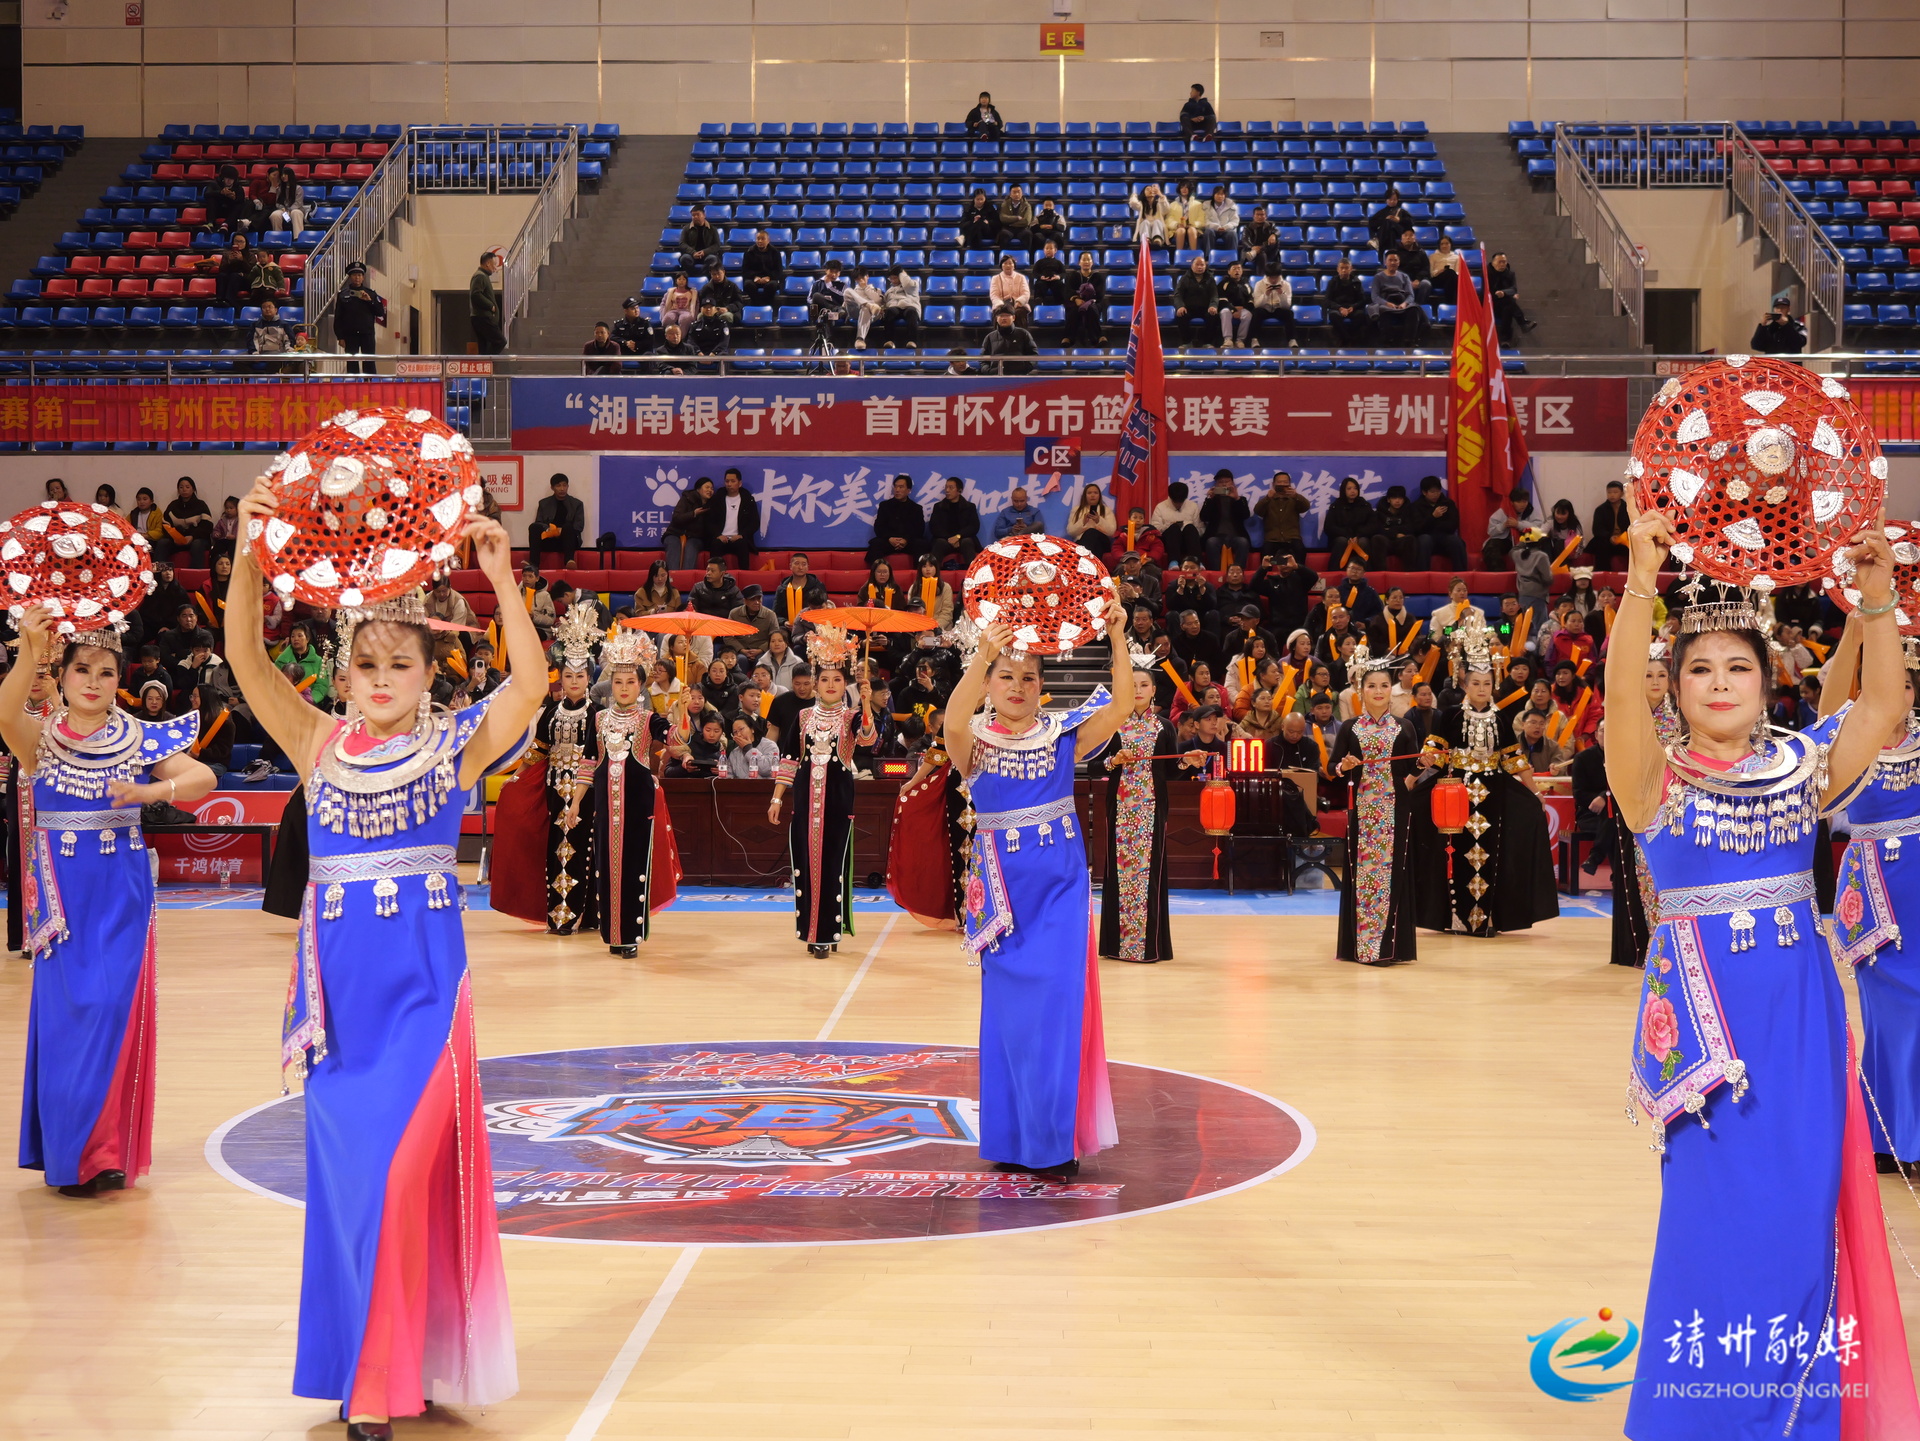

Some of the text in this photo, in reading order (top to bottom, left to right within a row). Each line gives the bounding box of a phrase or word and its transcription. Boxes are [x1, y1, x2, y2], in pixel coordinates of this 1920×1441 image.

[461, 362, 491, 373] 禁止吸烟
[862, 395, 1270, 437] 首届怀化市篮联赛
[1033, 446, 1072, 468] C区
[174, 857, 244, 875] 千鸿体育
[860, 1172, 1040, 1182] 湖南银行杯
